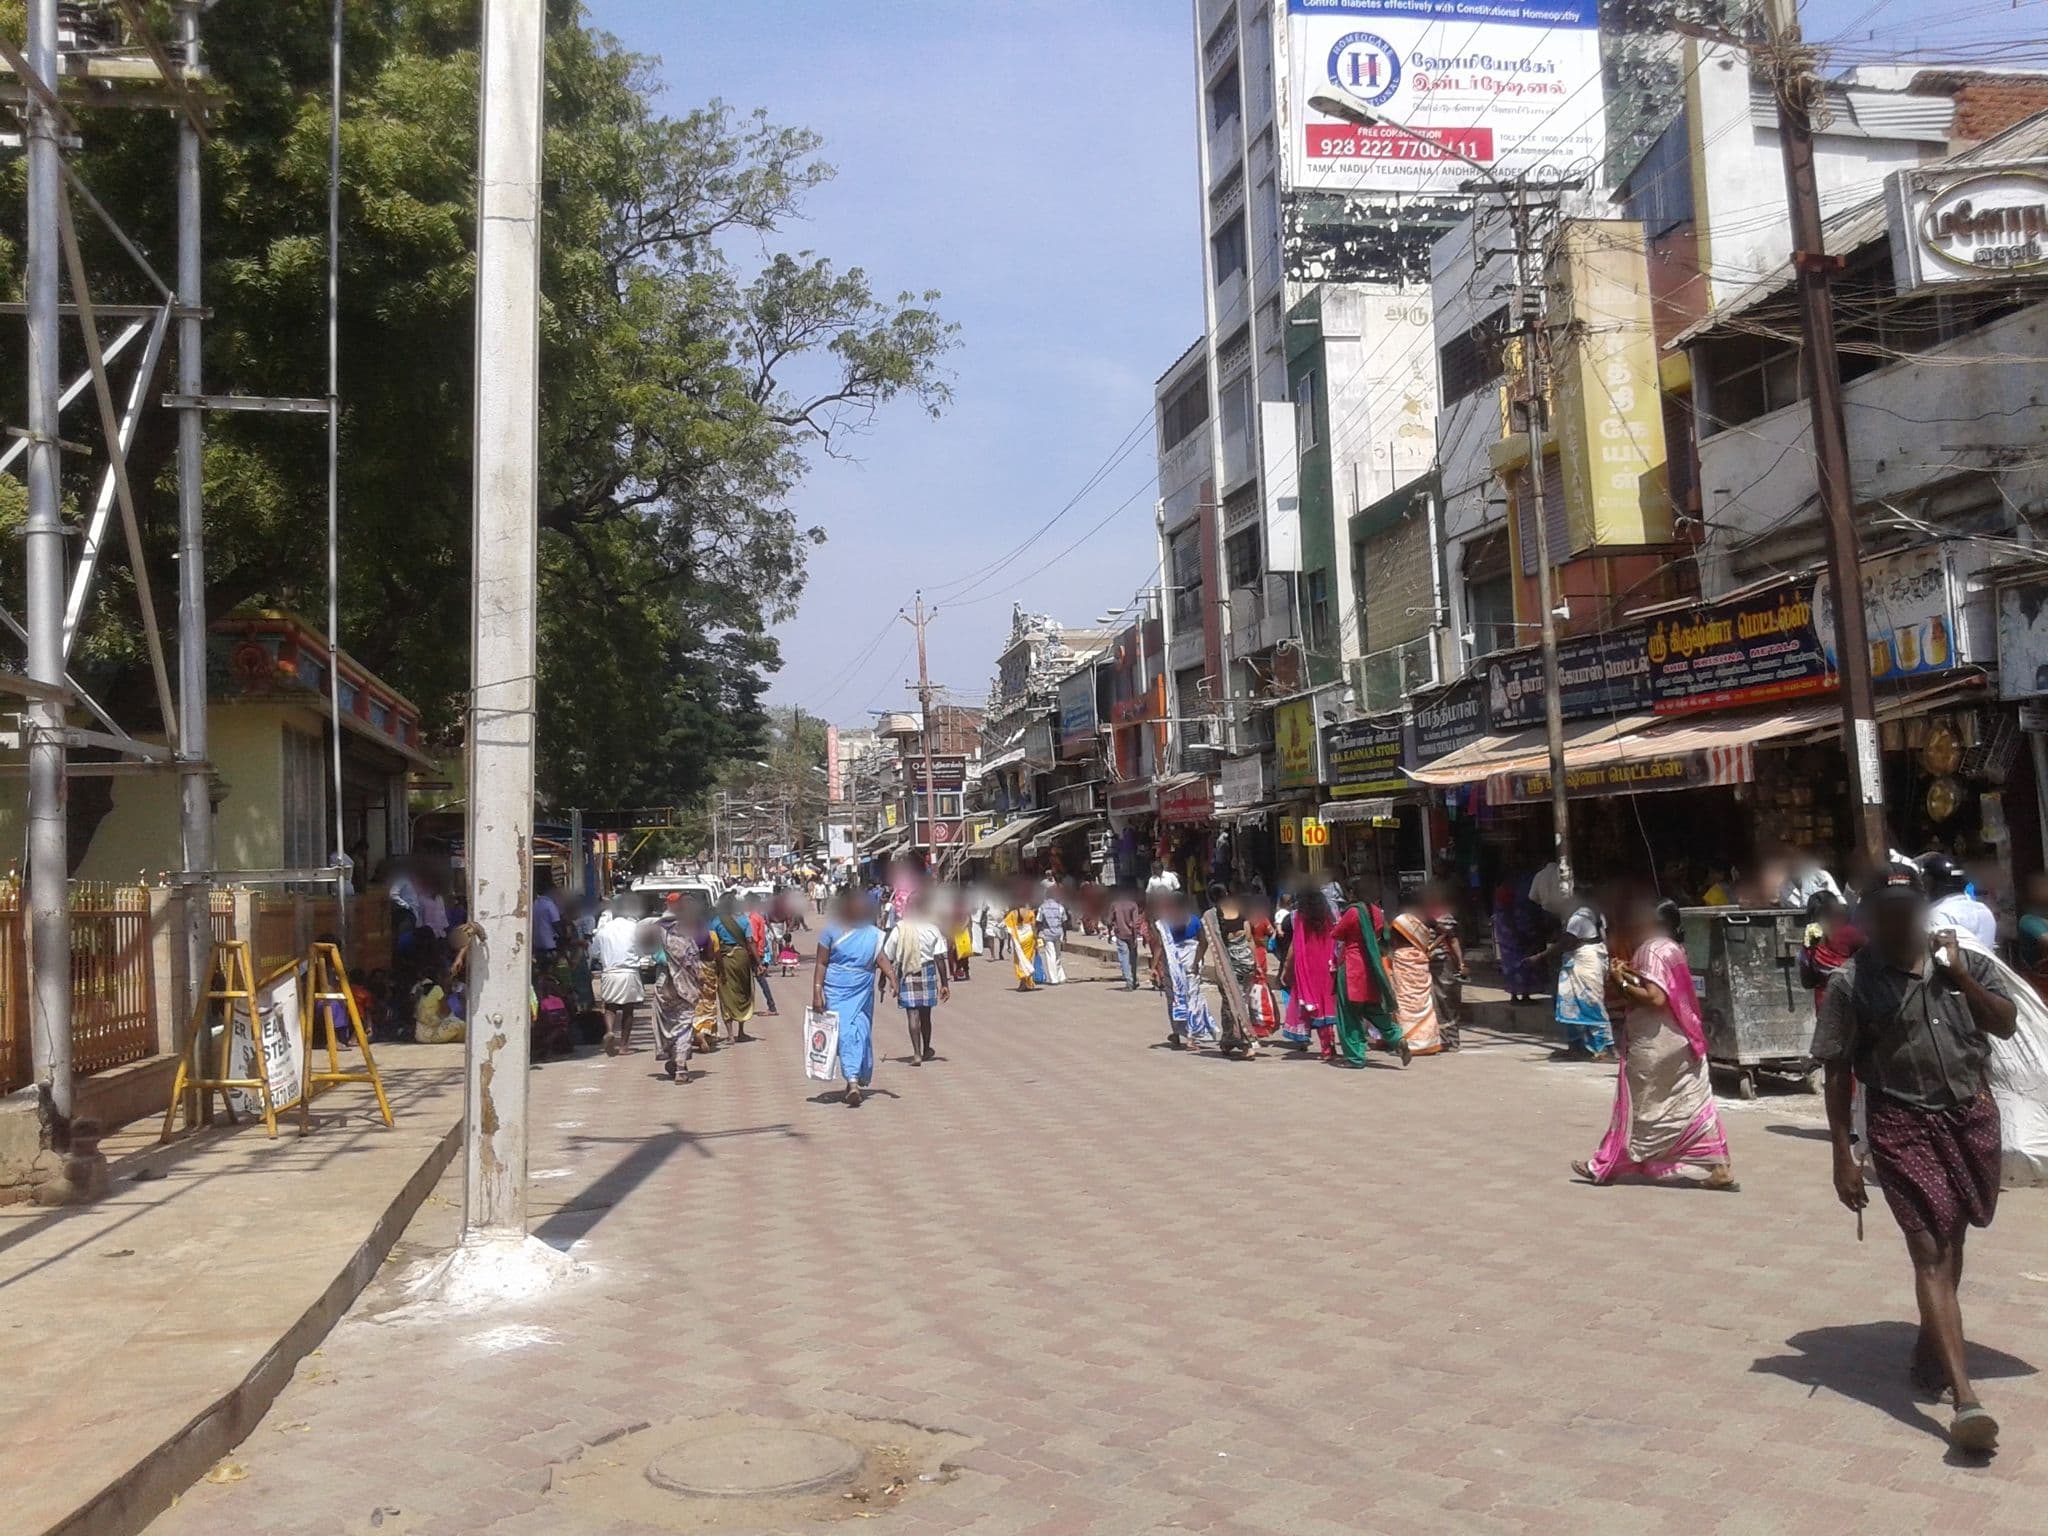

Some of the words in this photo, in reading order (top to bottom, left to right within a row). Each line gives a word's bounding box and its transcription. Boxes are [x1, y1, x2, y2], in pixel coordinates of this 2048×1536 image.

[1384, 0, 1432, 12] effectively
[1435, 3, 1454, 13] with
[1457, 3, 1520, 18] Constitutional
[1522, 8, 1580, 22] Homeopathy
[1358, 127, 1378, 137] FREE
[1321, 139, 1355, 155] 928
[1360, 141, 1392, 157] 222
[1307, 164, 1336, 173] TAMIL
[1340, 164, 1367, 174] NADU
[1376, 166, 1432, 175] TELANGANA
[1669, 614, 1732, 657] கிருஷ்ணா
[1693, 651, 1745, 668] KRISHNA
[1750, 640, 1800, 658] METALS
[1376, 742, 1400, 757] STORE
[1305, 827, 1325, 844] 10
